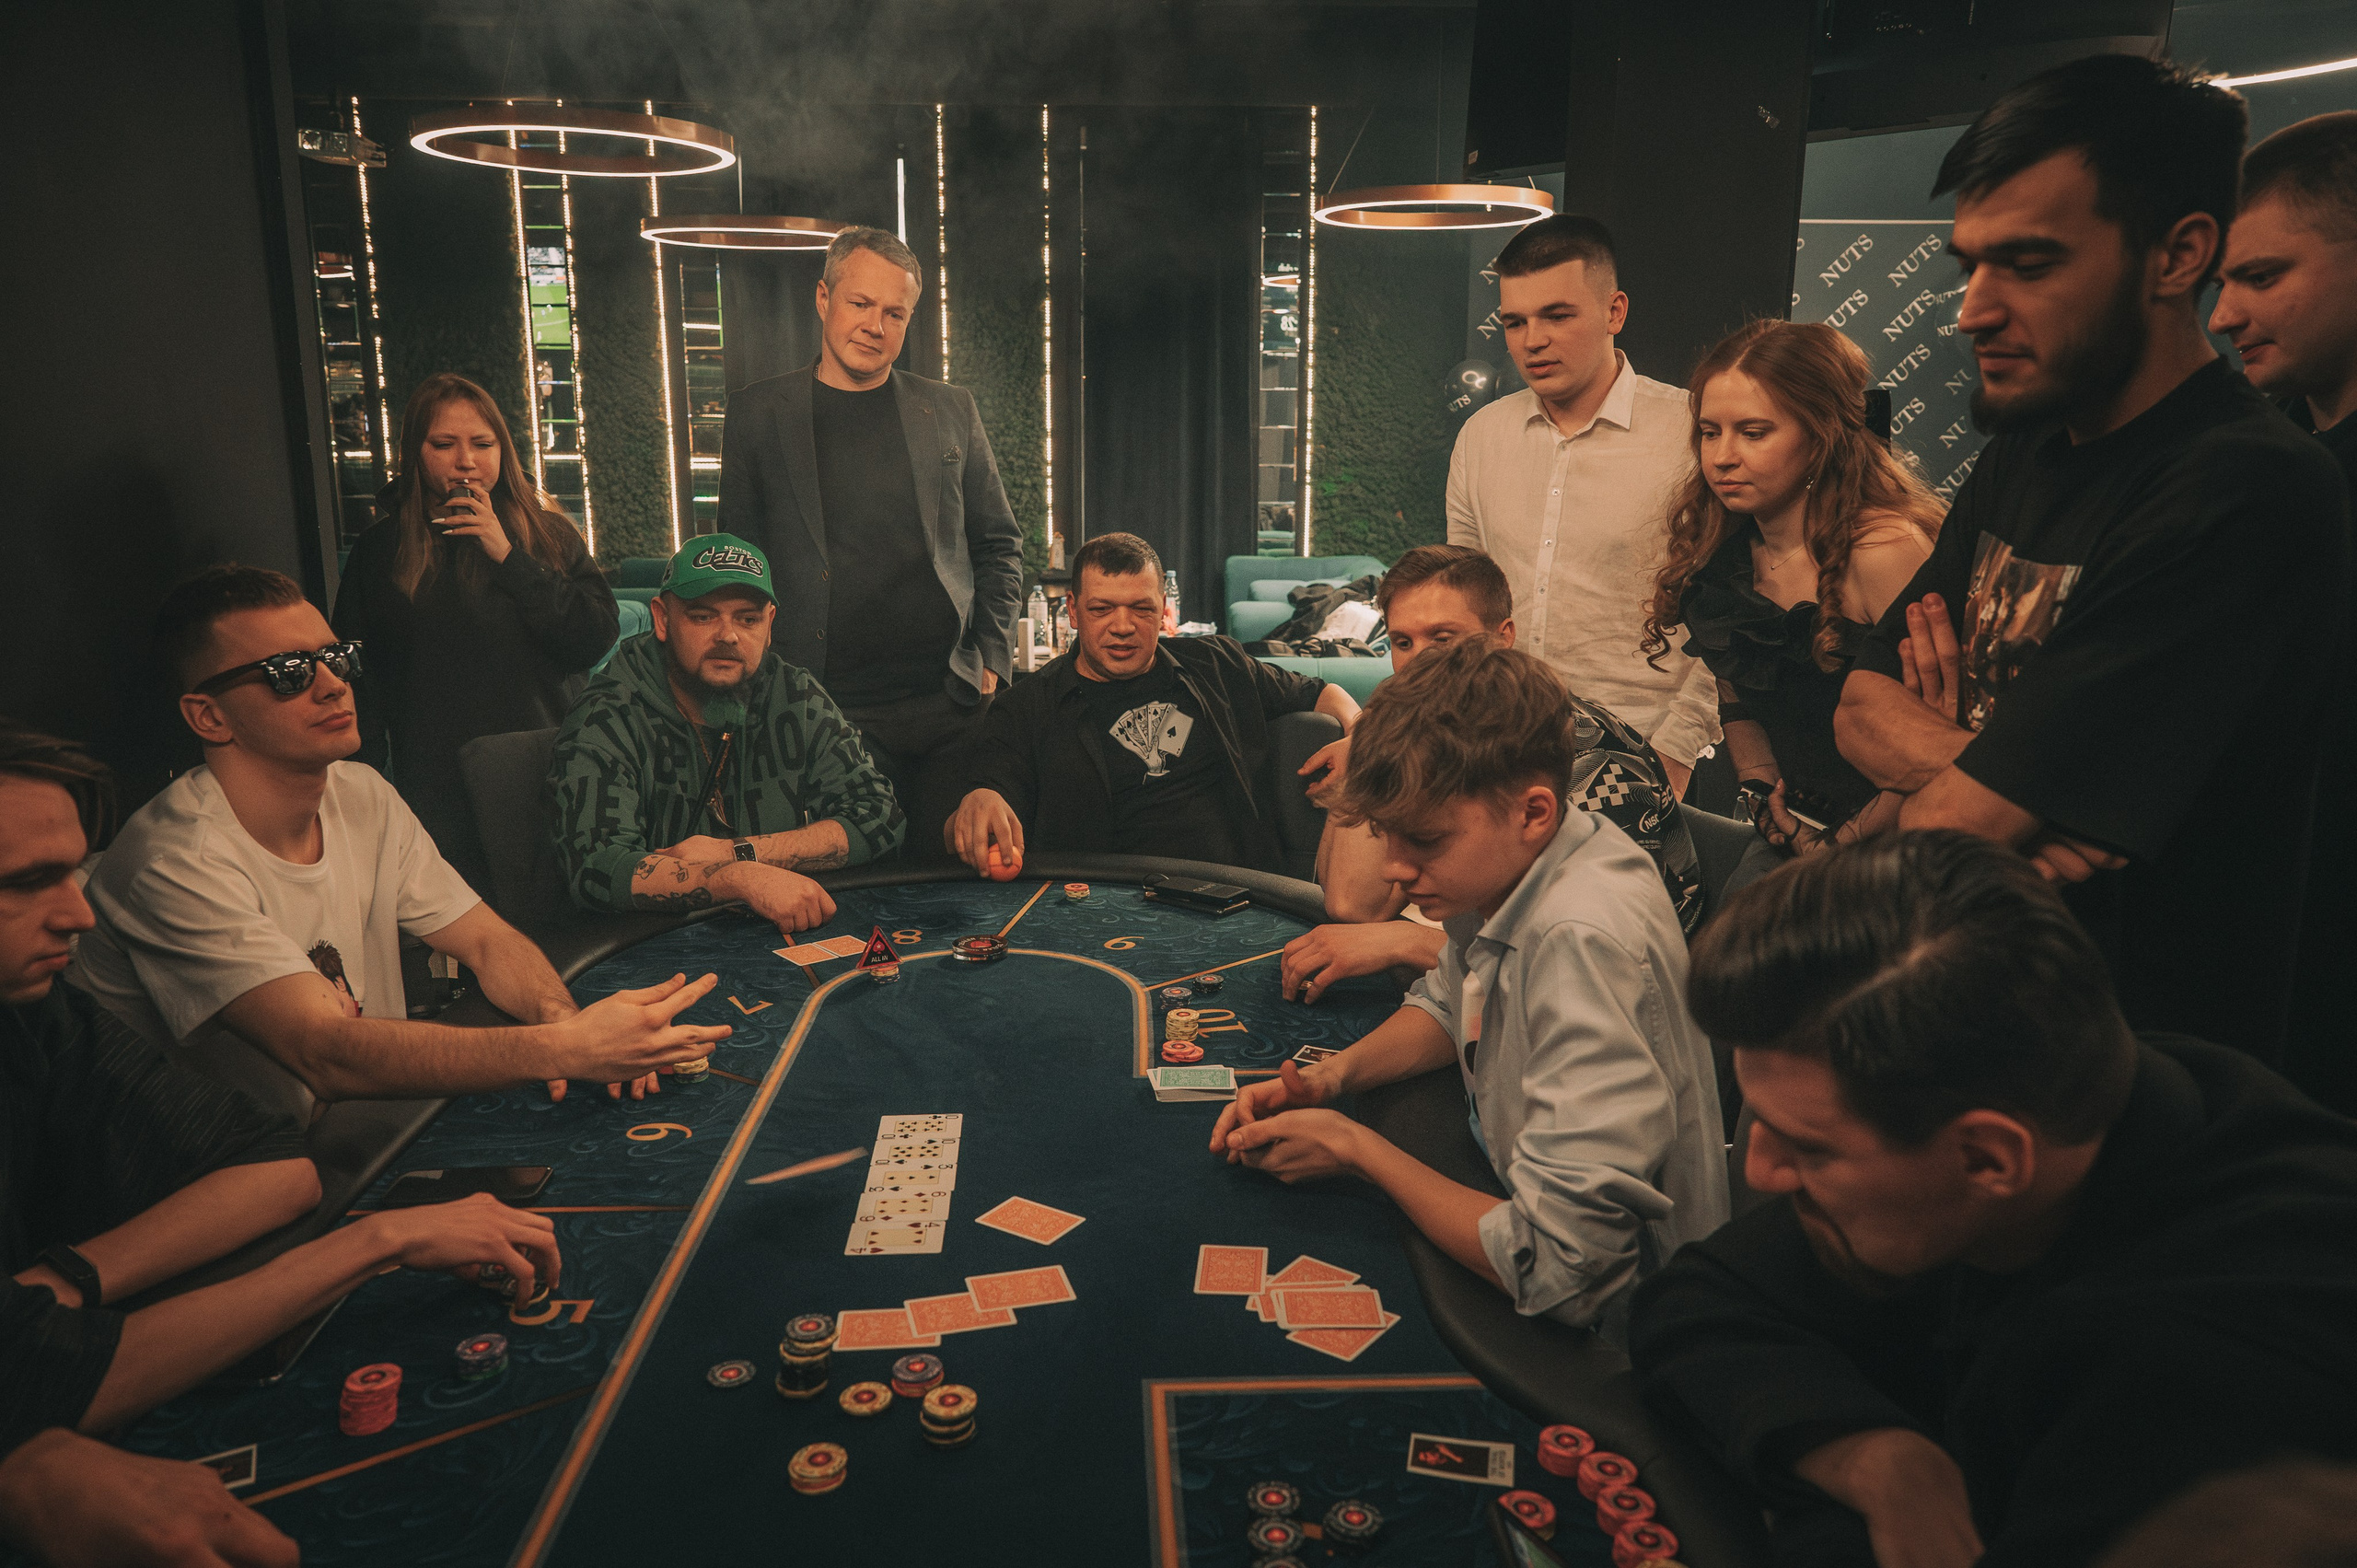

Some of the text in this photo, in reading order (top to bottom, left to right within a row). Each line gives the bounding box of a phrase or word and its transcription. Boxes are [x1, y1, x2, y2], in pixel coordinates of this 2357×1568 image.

[1818, 234, 1874, 288] NUTS
[1887, 234, 1942, 288] NUTS
[1882, 289, 1935, 343] NUTS
[1877, 343, 1932, 390] NUTS
[1890, 397, 1926, 436] UTS
[724, 545, 752, 557] BOSTON
[892, 930, 923, 945] 8
